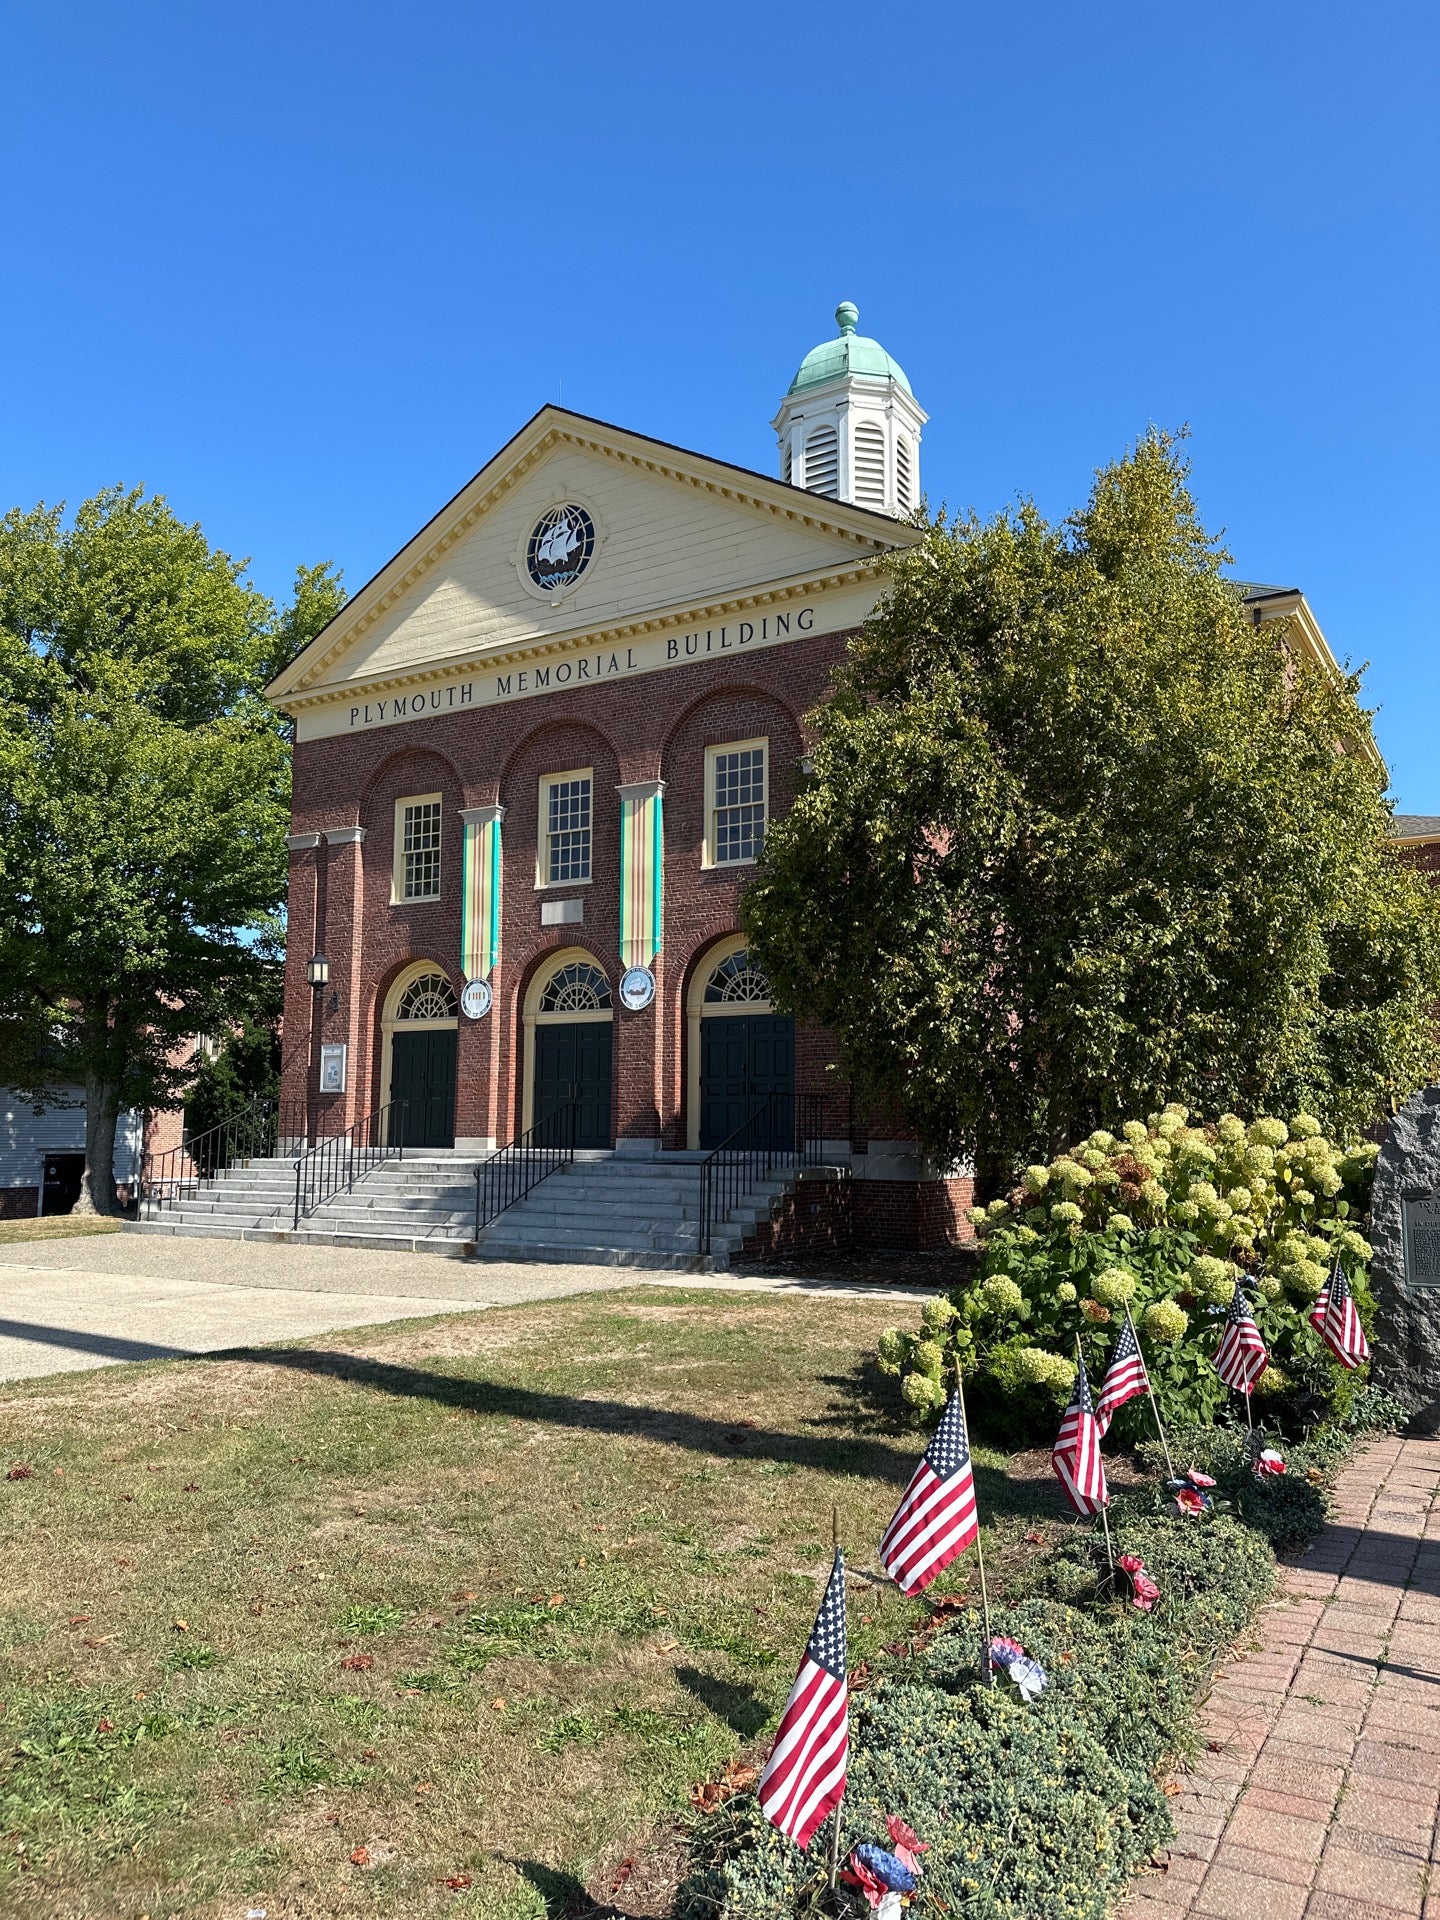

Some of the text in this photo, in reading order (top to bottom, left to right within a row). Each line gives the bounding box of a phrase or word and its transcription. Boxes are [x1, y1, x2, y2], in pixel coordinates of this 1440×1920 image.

[350, 608, 814, 726] PLYMOUTH MEMORIAL BUILDING
